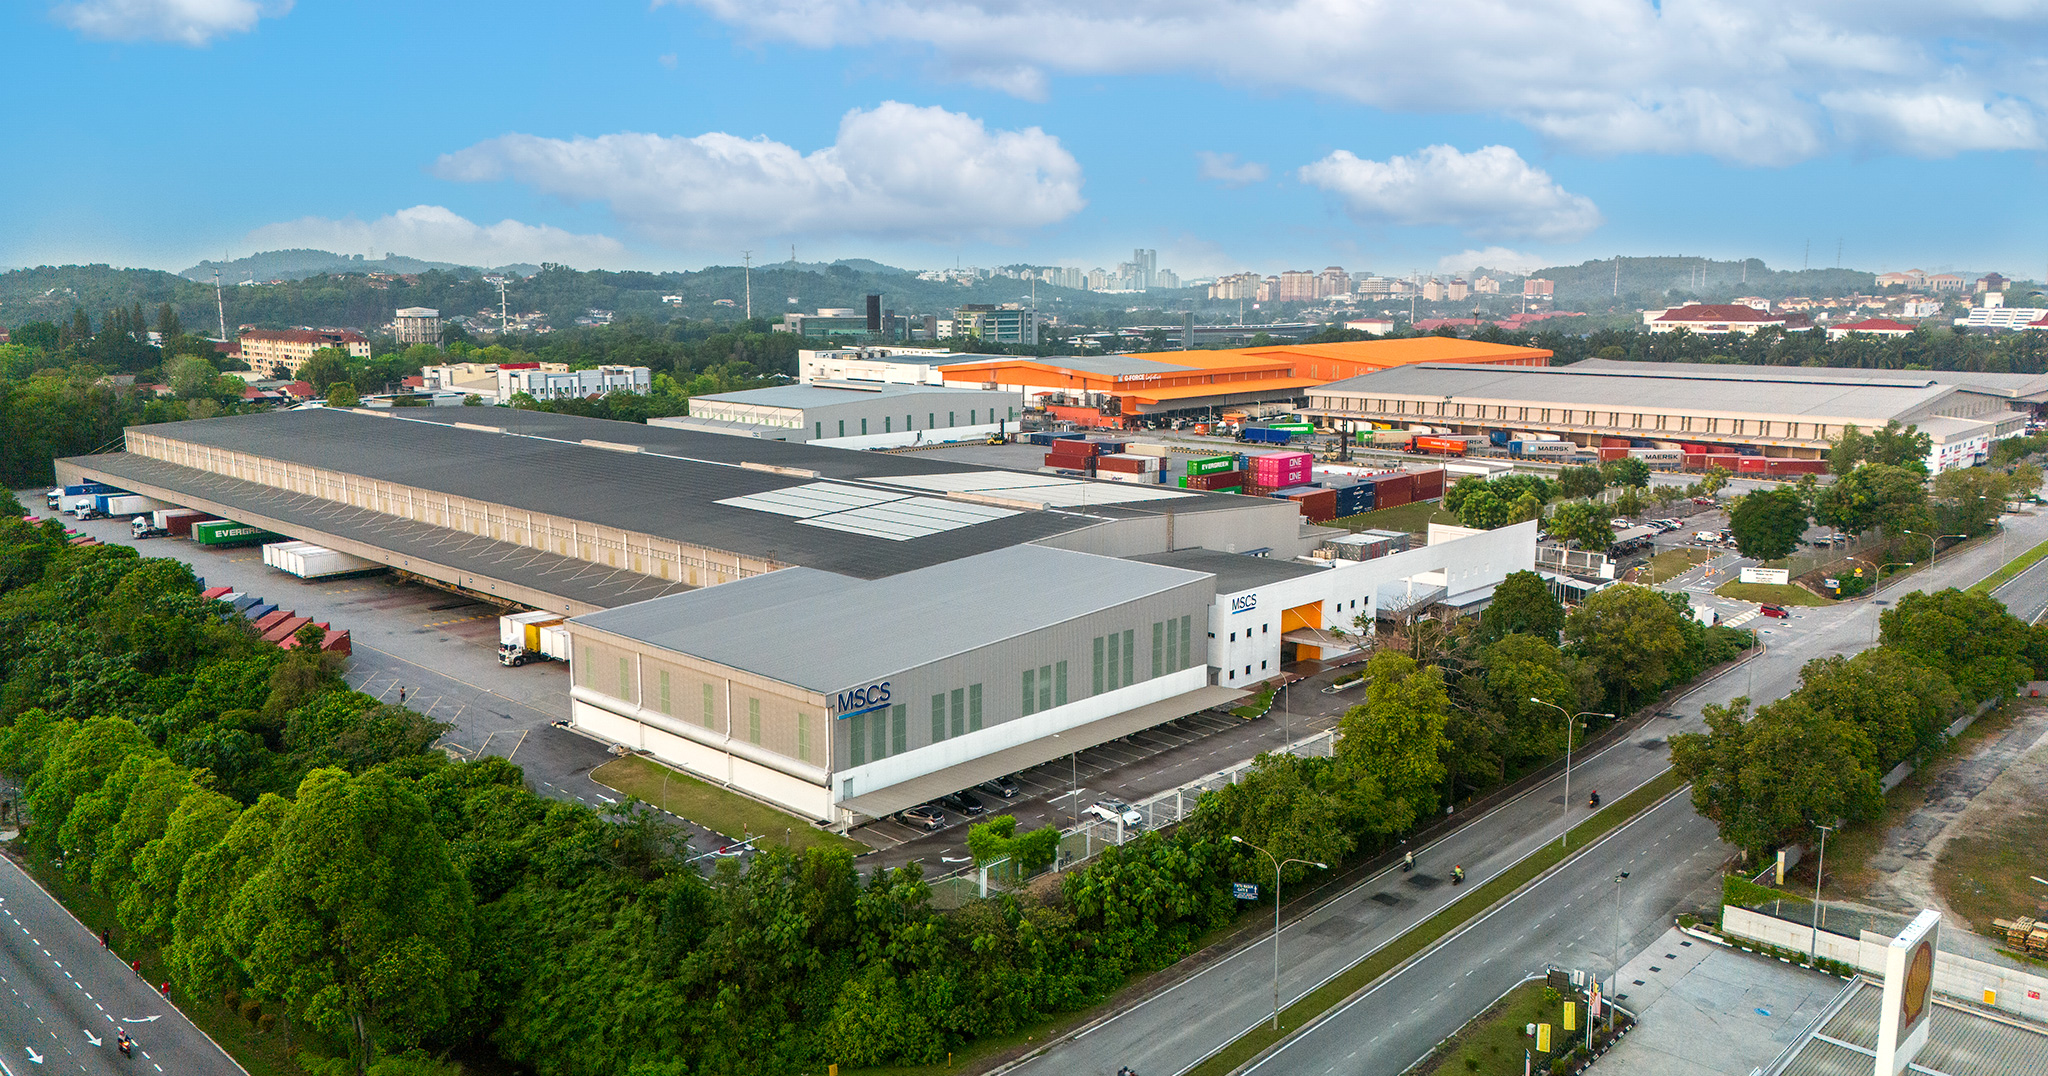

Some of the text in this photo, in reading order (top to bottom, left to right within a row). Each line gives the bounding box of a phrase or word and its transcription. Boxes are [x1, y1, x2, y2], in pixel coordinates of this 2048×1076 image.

[1201, 461, 1229, 470] EVERGREEN
[1289, 457, 1302, 466] ONE
[1289, 471, 1301, 480] ONE
[1232, 593, 1257, 610] MSCS
[837, 681, 891, 713] MSCS
